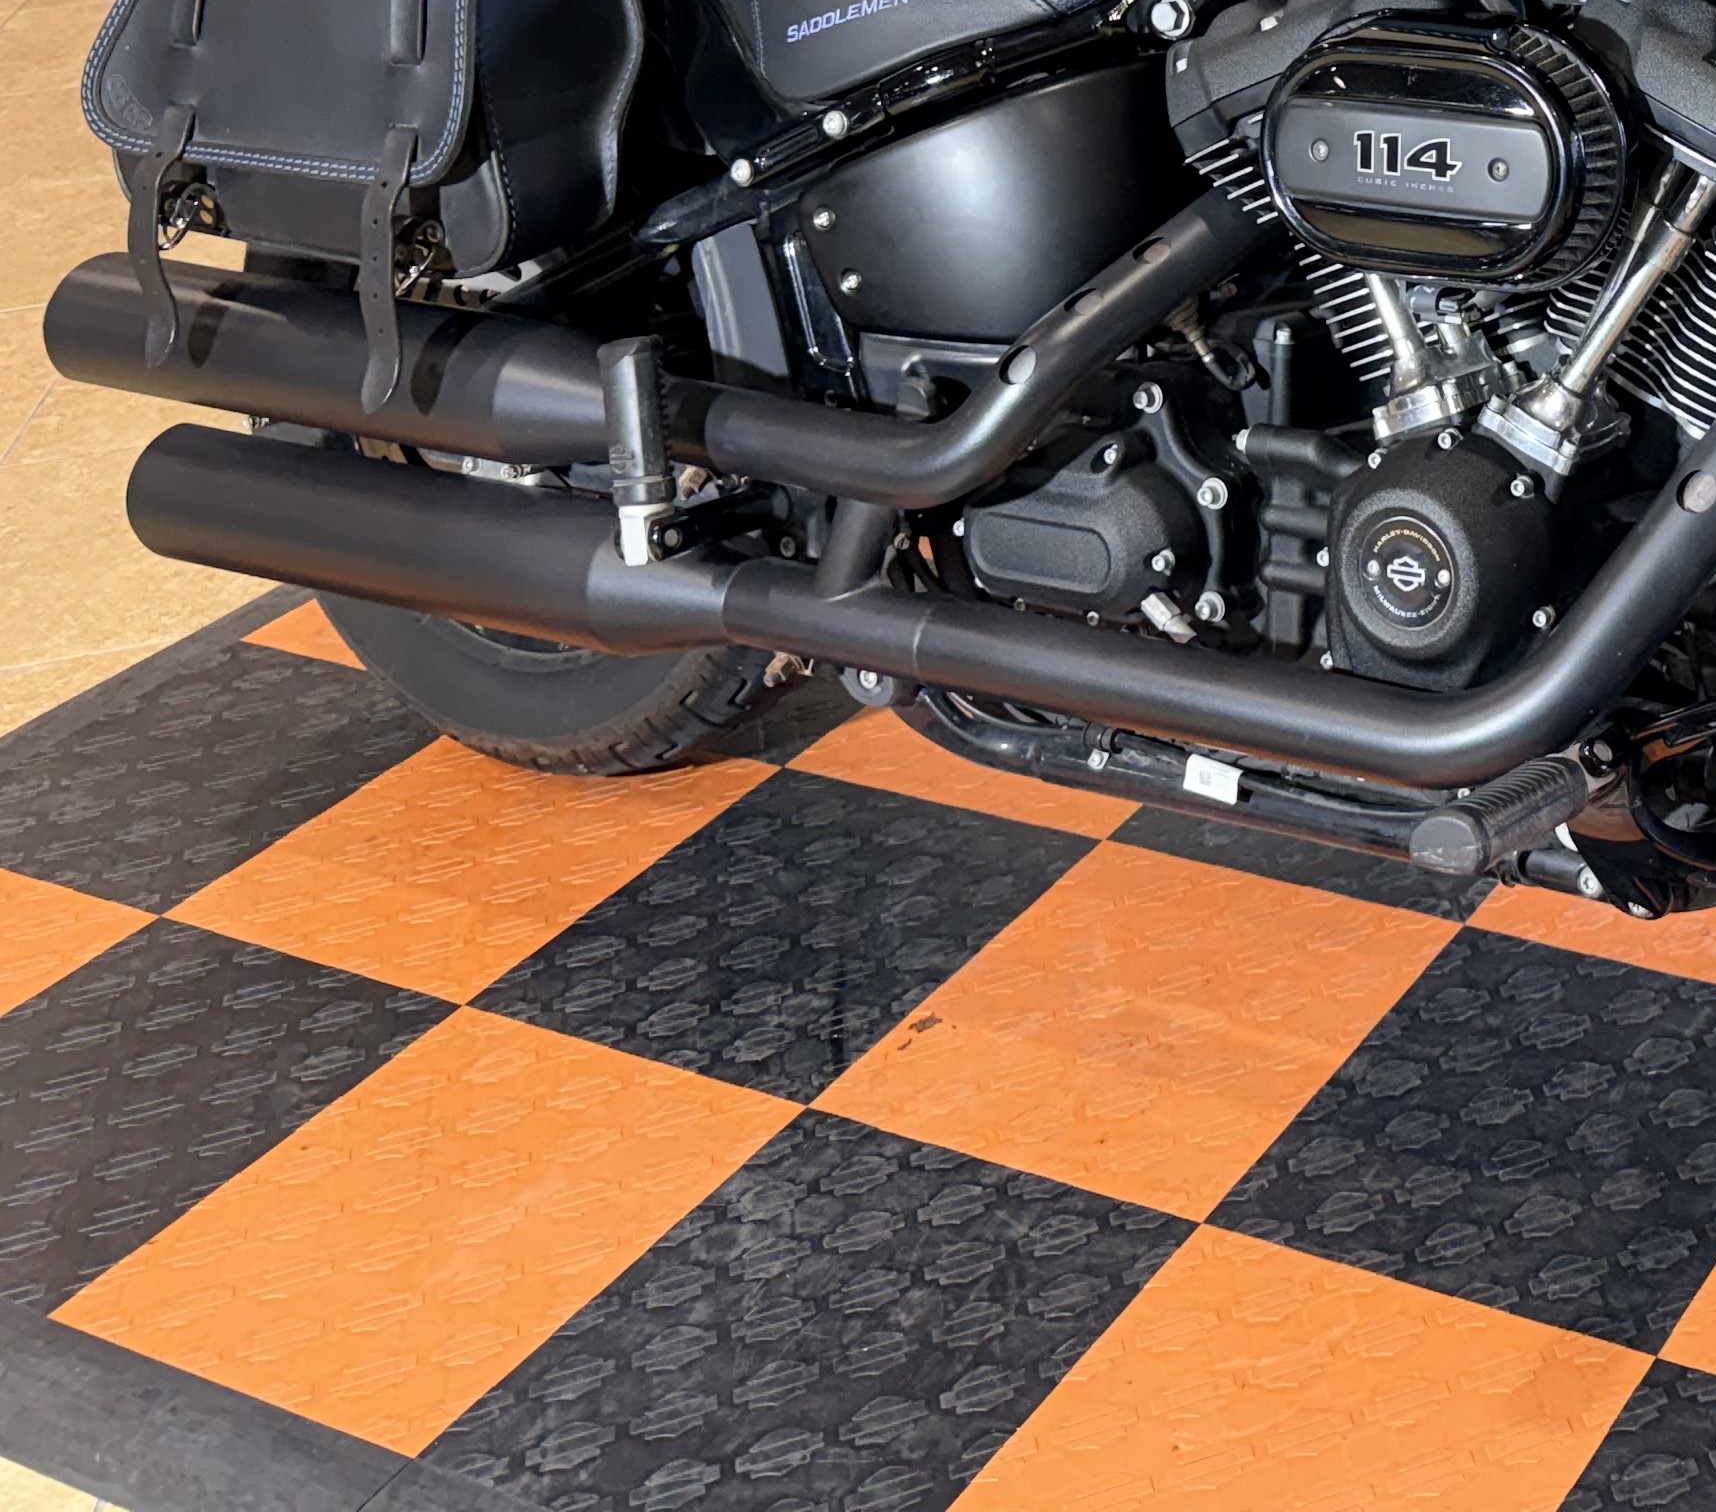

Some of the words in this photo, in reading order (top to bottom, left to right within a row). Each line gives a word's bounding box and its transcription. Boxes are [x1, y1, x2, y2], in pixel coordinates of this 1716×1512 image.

[1353, 129, 1463, 181] 114
[1357, 176, 1398, 188] CUBIC
[1405, 181, 1455, 193] INCHES
[1373, 528, 1441, 562] HARLEY-DAVIDSON
